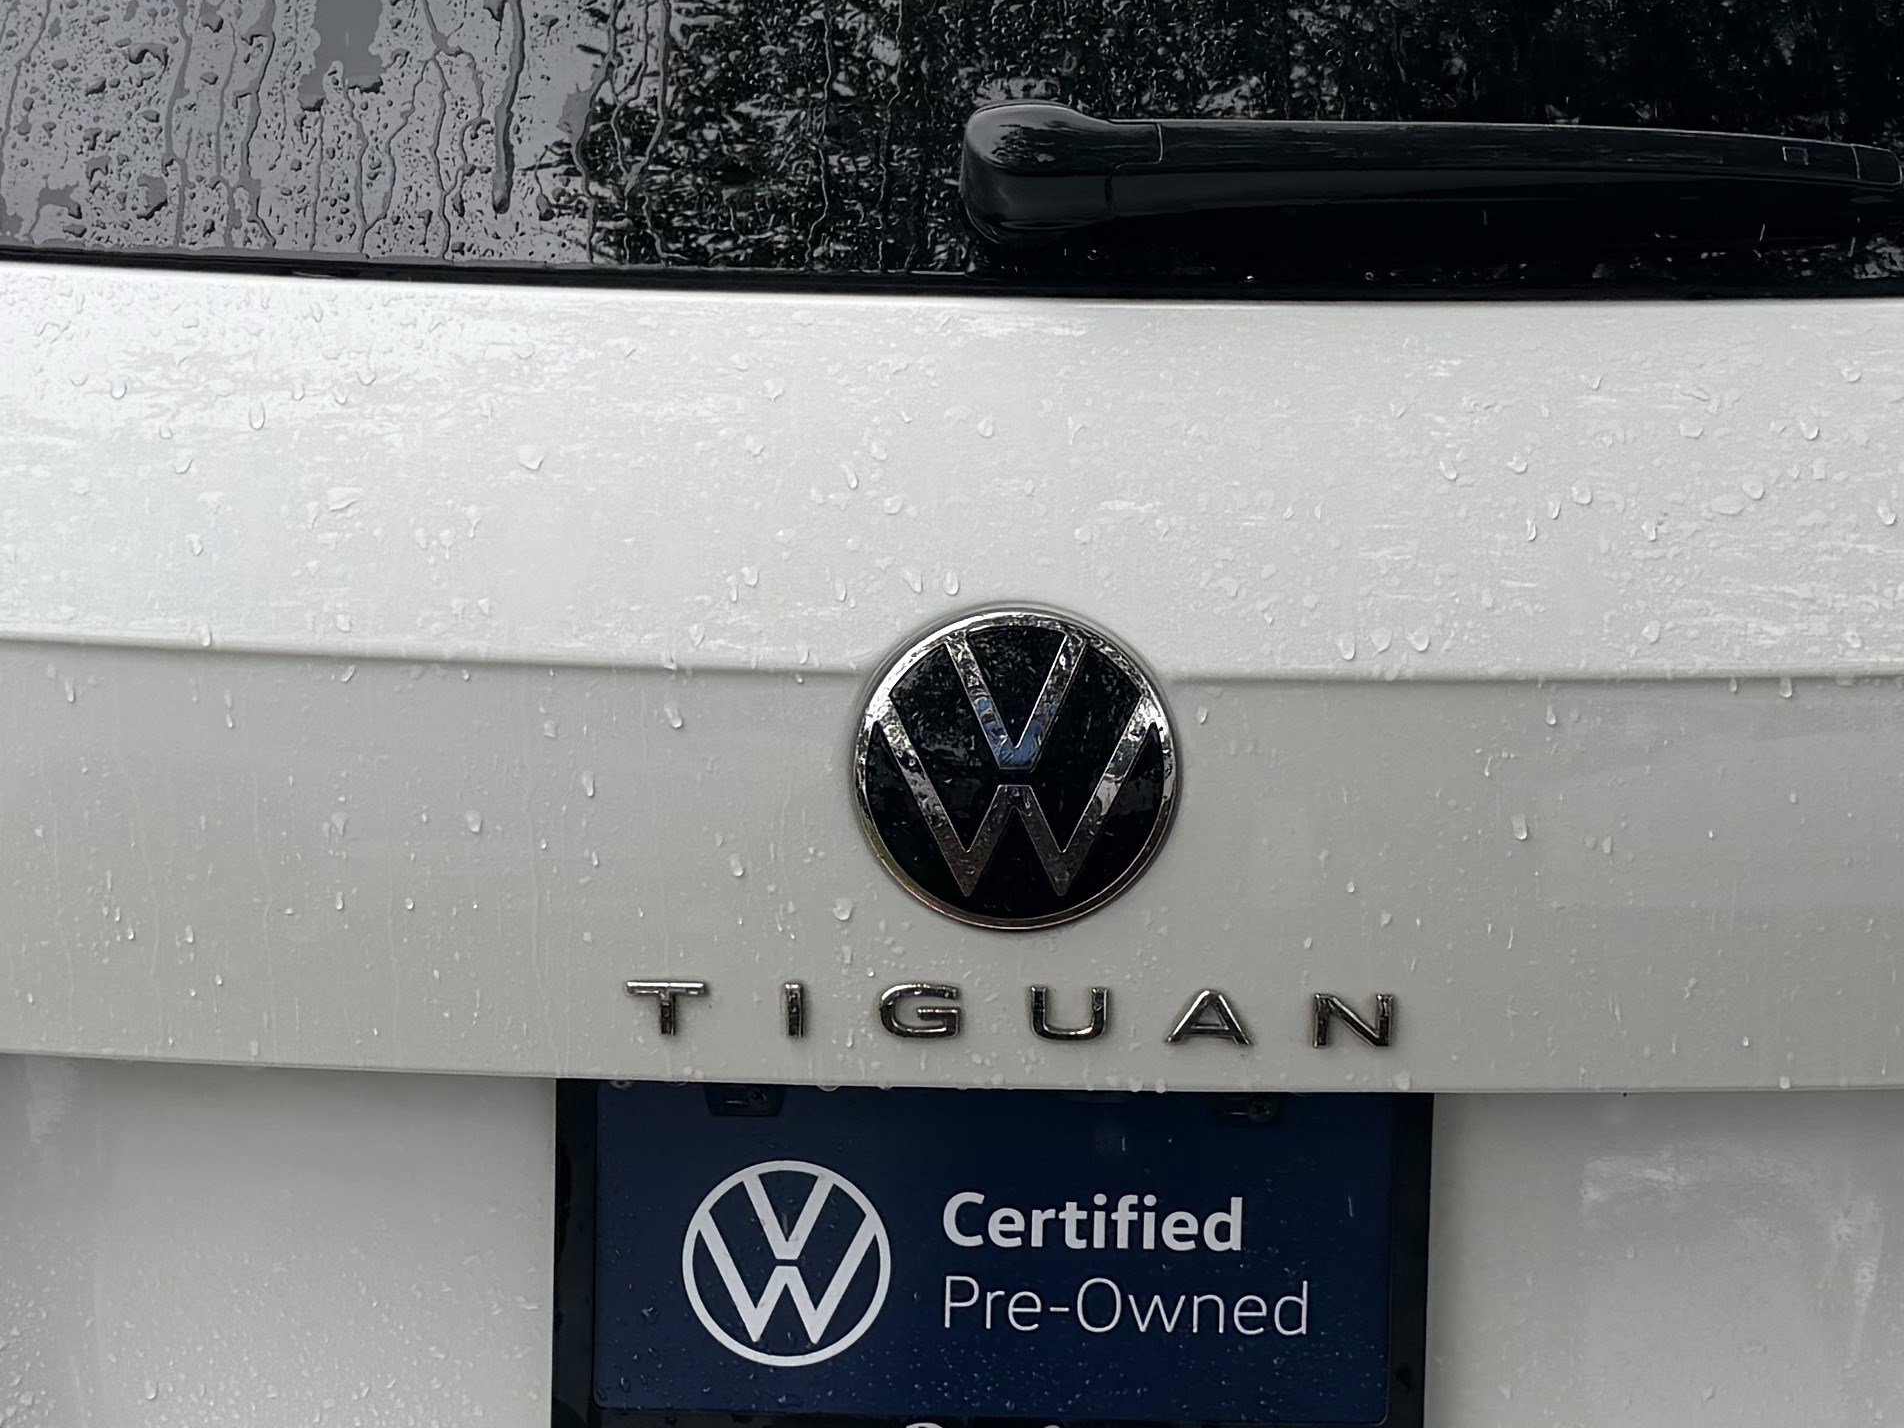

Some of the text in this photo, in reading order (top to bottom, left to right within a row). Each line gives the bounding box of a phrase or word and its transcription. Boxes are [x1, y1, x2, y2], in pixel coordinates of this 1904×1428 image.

[624, 977, 1399, 1049] TIGUAN
[941, 1190, 1245, 1253] Certified
[942, 1274, 1311, 1337] Pre-Owned
